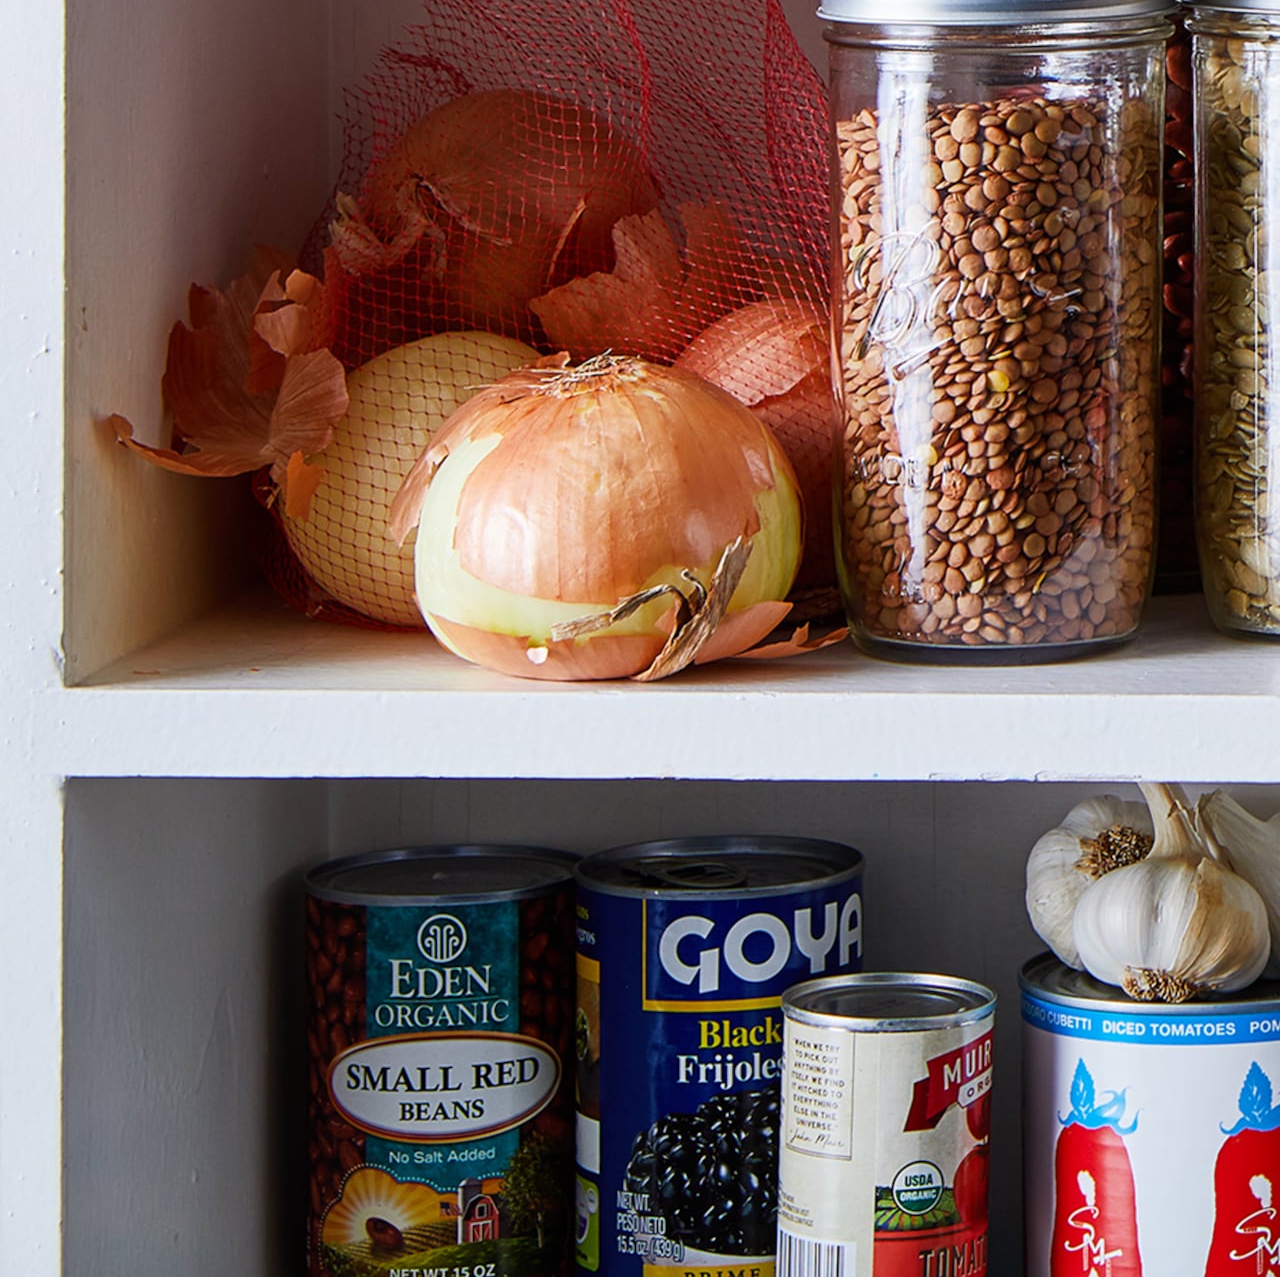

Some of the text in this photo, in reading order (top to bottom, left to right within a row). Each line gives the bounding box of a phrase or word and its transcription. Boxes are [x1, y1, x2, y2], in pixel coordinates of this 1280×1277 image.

[658, 892, 863, 993] GOYA
[389, 958, 493, 999] EDEN
[374, 999, 511, 1029] ORGANIC
[1046, 1010, 1093, 1032] CUBETTI
[1102, 1019, 1147, 1037] DICED
[1150, 1021, 1236, 1038] TOMATOES
[698, 1019, 781, 1050] Black
[794, 1062, 827, 1074] ANYTHING
[822, 1055, 839, 1065] OUT
[943, 1042, 992, 1091] MUIR
[345, 1056, 540, 1094] SMALL RED
[676, 1054, 784, 1092] Frijoles
[825, 1078, 845, 1088] FIND
[793, 1093, 839, 1110] EVERYTHING
[797, 1085, 844, 1099] HITCHED TO
[398, 1098, 486, 1122] BEANS
[793, 1105, 837, 1121] ELSE THE
[388, 1146, 496, 1164] No Salt Added
[904, 1174, 934, 1188] USDA
[616, 1191, 652, 1212] NET WT.
[899, 1189, 938, 1202] ORGANIC
[616, 1212, 667, 1236] PESO NETO
[616, 1236, 636, 1253] 15.5
[918, 1232, 988, 1277] TOMAT
